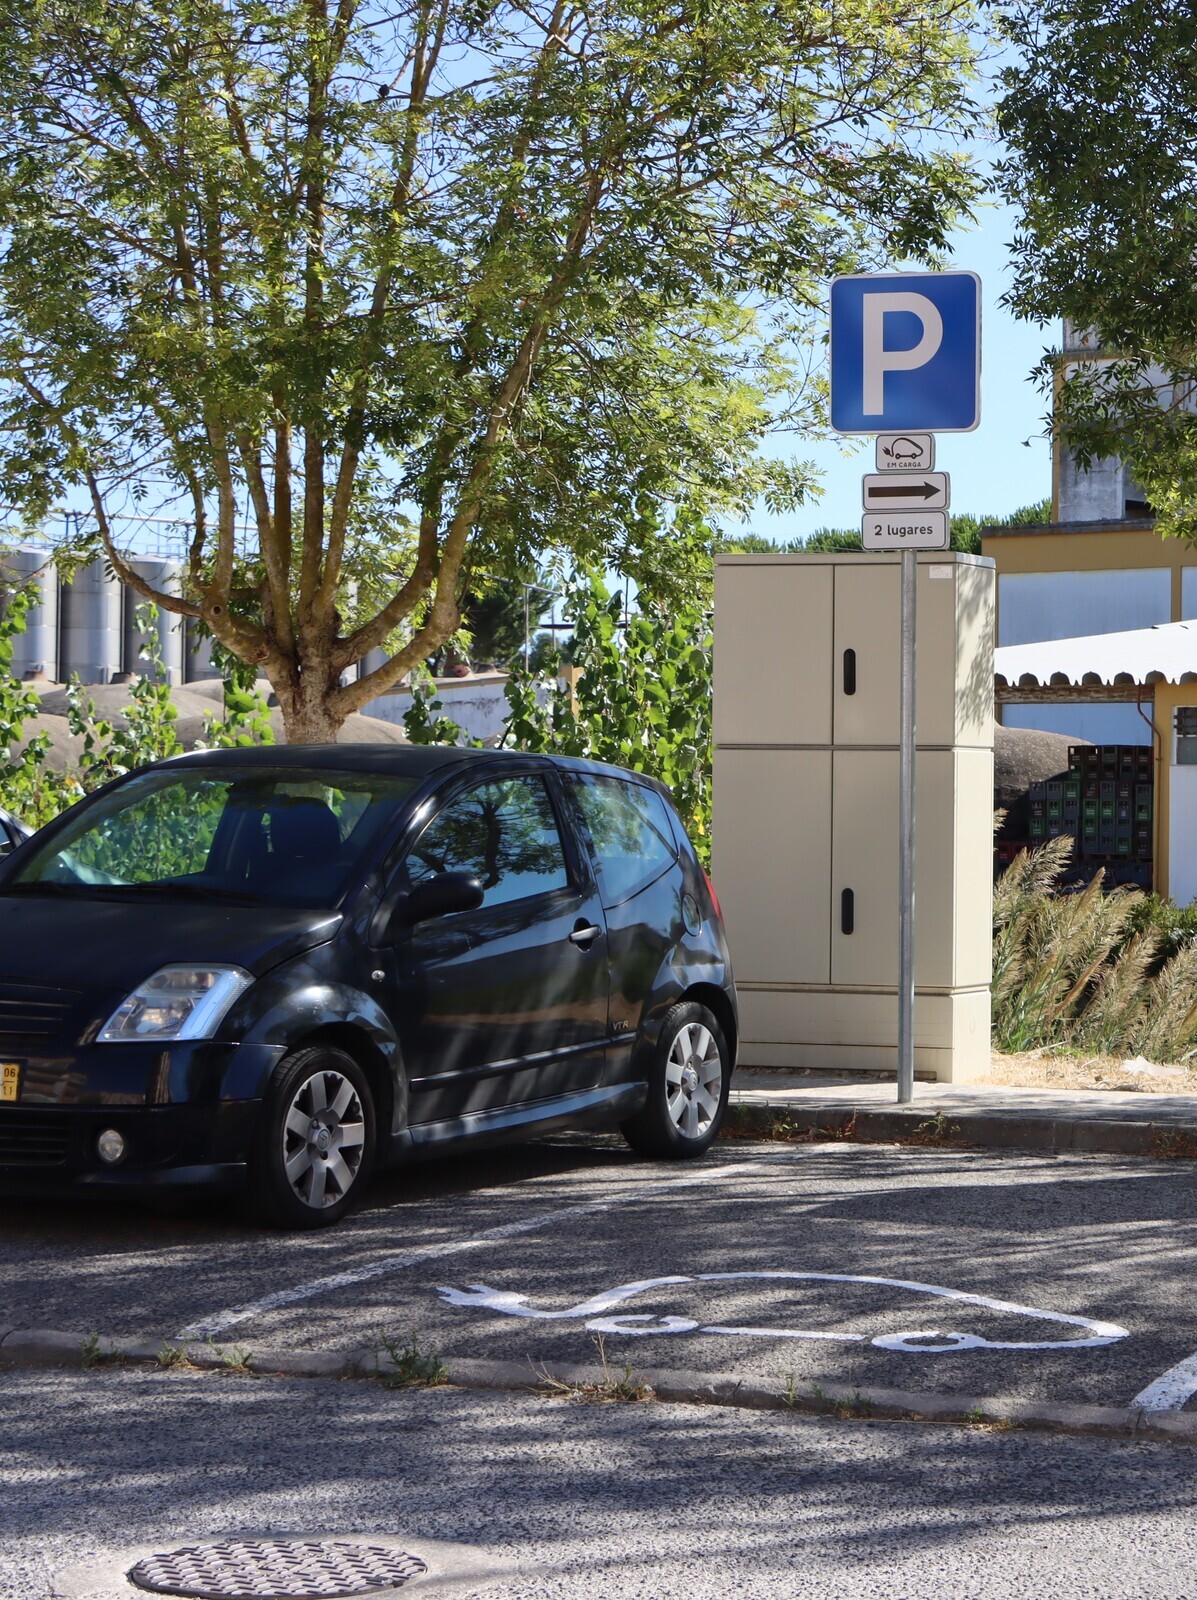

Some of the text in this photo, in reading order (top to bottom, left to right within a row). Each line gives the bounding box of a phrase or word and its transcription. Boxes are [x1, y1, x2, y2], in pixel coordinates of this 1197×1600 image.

[862, 291, 944, 416] P
[874, 524, 933, 537] 2 lugares
[612, 1020, 629, 1030] VTR
[4, 1068, 16, 1077] 06
[3, 1085, 13, 1096] 11
